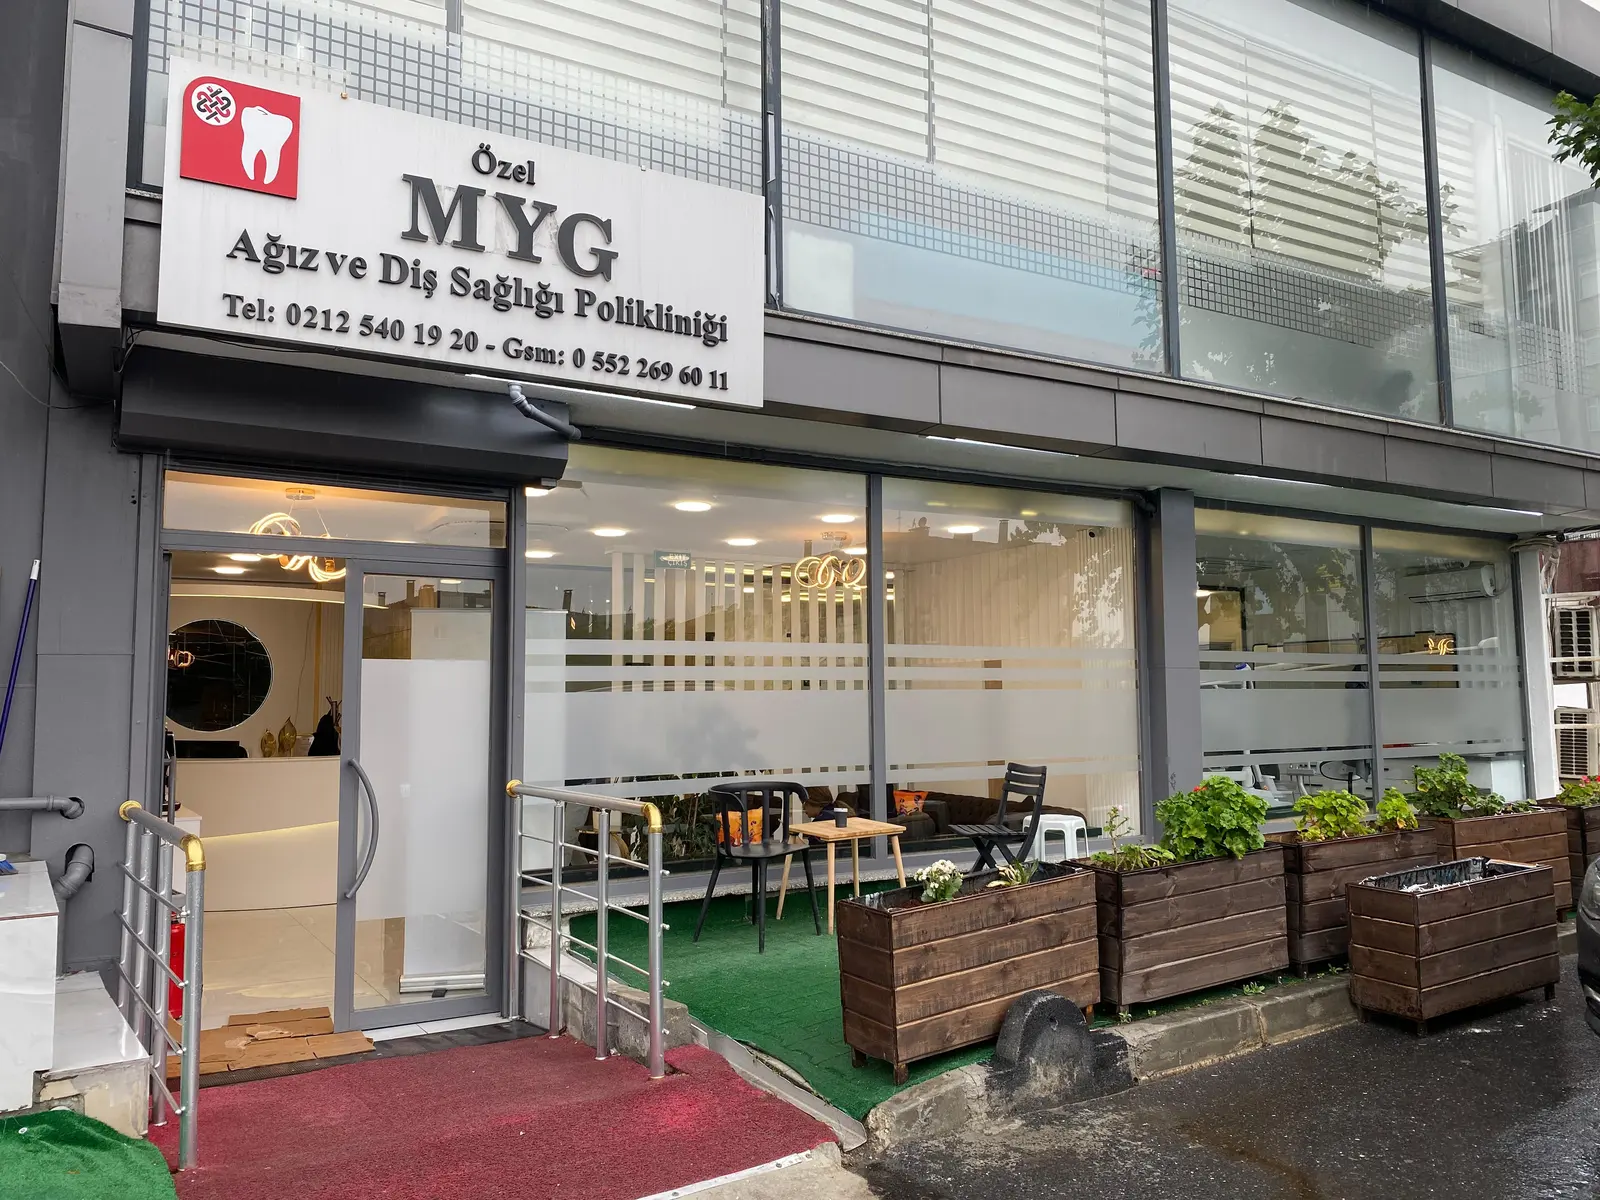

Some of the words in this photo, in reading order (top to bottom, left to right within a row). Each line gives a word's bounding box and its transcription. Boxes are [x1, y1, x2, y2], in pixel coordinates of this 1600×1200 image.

[471, 142, 536, 187] Özel
[400, 173, 619, 283] MYG
[225, 228, 320, 276] Ağız
[325, 252, 368, 280] ve
[377, 253, 438, 299] Diş
[449, 266, 565, 320] Sağlığı
[573, 287, 729, 348] Polikliniği
[222, 293, 276, 323] Tel:
[285, 302, 351, 334] 0212
[358, 314, 406, 342] 540
[413, 323, 443, 347] 19
[449, 328, 479, 353] 20
[502, 337, 565, 367] Gsm:
[572, 347, 586, 369] 0
[591, 350, 630, 376] 552
[636, 357, 674, 383] 269
[678, 365, 703, 388] 60
[708, 369, 729, 391] 11
